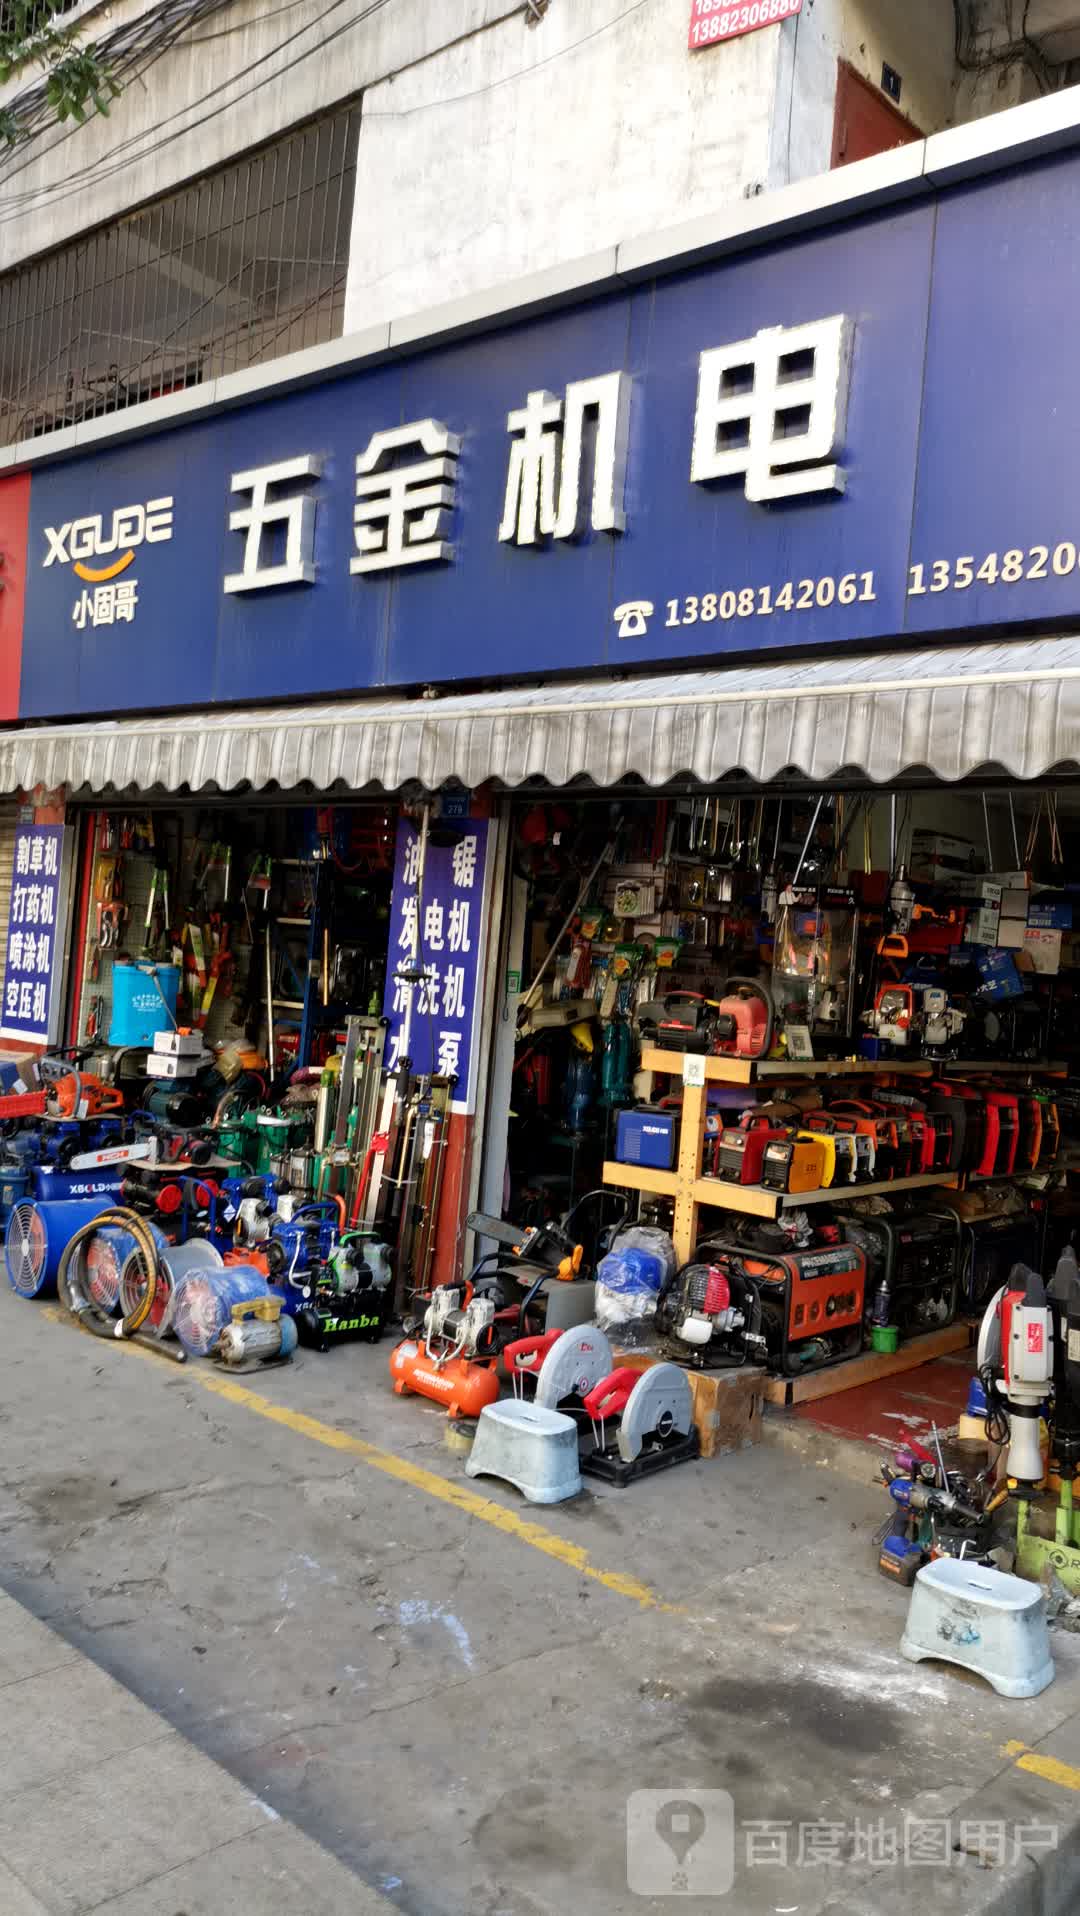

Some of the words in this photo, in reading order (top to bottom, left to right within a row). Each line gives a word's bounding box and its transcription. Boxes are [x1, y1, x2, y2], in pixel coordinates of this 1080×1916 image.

[224, 314, 856, 595] 五金机电
[72, 580, 139, 628] 小固哥
[664, 571, 878, 627] 13808142061
[908, 541, 1080, 596] 1354820
[17, 835, 58, 876] 割草机
[13, 882, 54, 925] 打药机
[398, 896, 471, 952] 发电机
[9, 930, 50, 973] 喷涂机
[5, 979, 47, 1023] 空压机
[323, 1314, 380, 1332] Hanba
